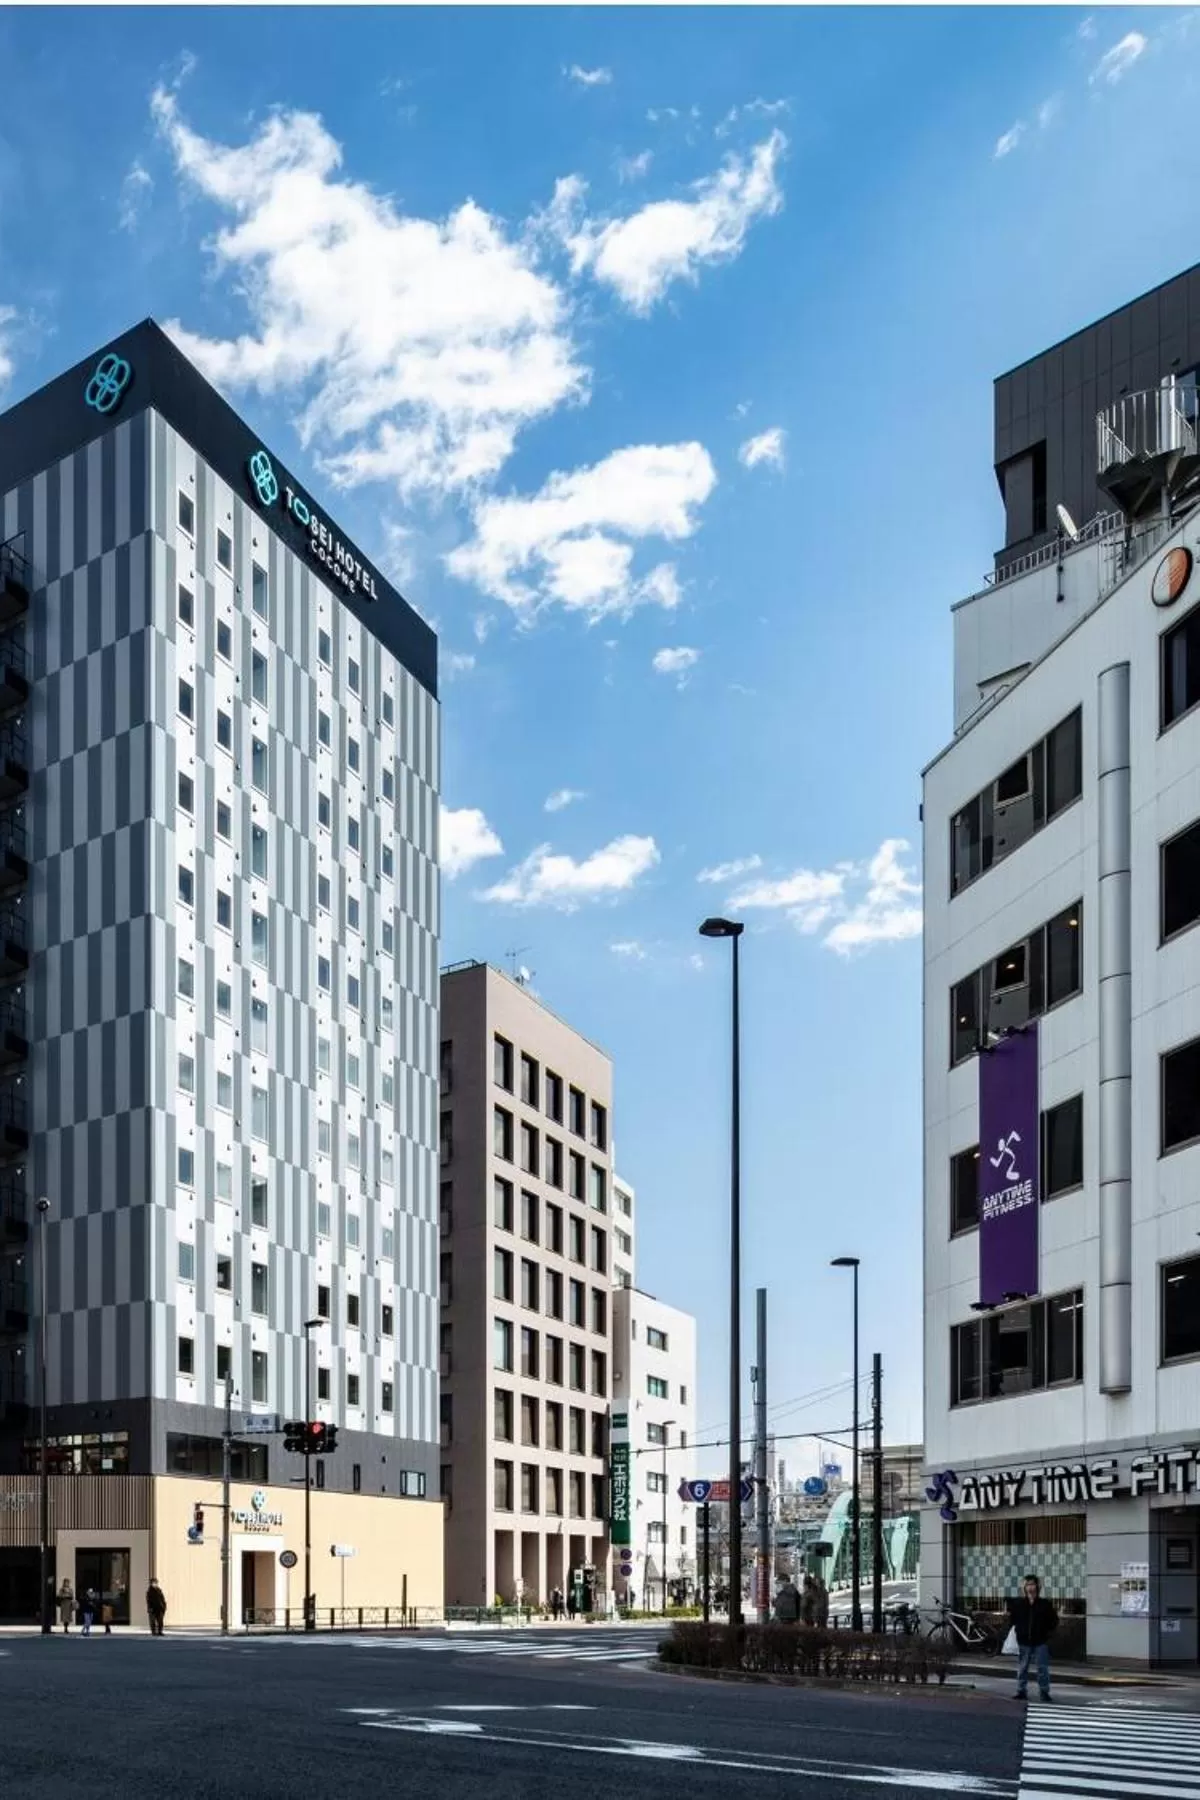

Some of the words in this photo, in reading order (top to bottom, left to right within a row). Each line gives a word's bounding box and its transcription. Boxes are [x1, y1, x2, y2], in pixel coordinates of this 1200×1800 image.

[336, 541, 378, 601] HOTEL
[983, 1179, 1033, 1211] ANYTIME
[983, 1193, 1033, 1221] FITNESS
[614, 1463, 628, 1521] エポック社
[693, 1483, 705, 1497] 6
[958, 1459, 1116, 1511] ANYTIME
[1131, 1448, 1200, 1497] FIT
